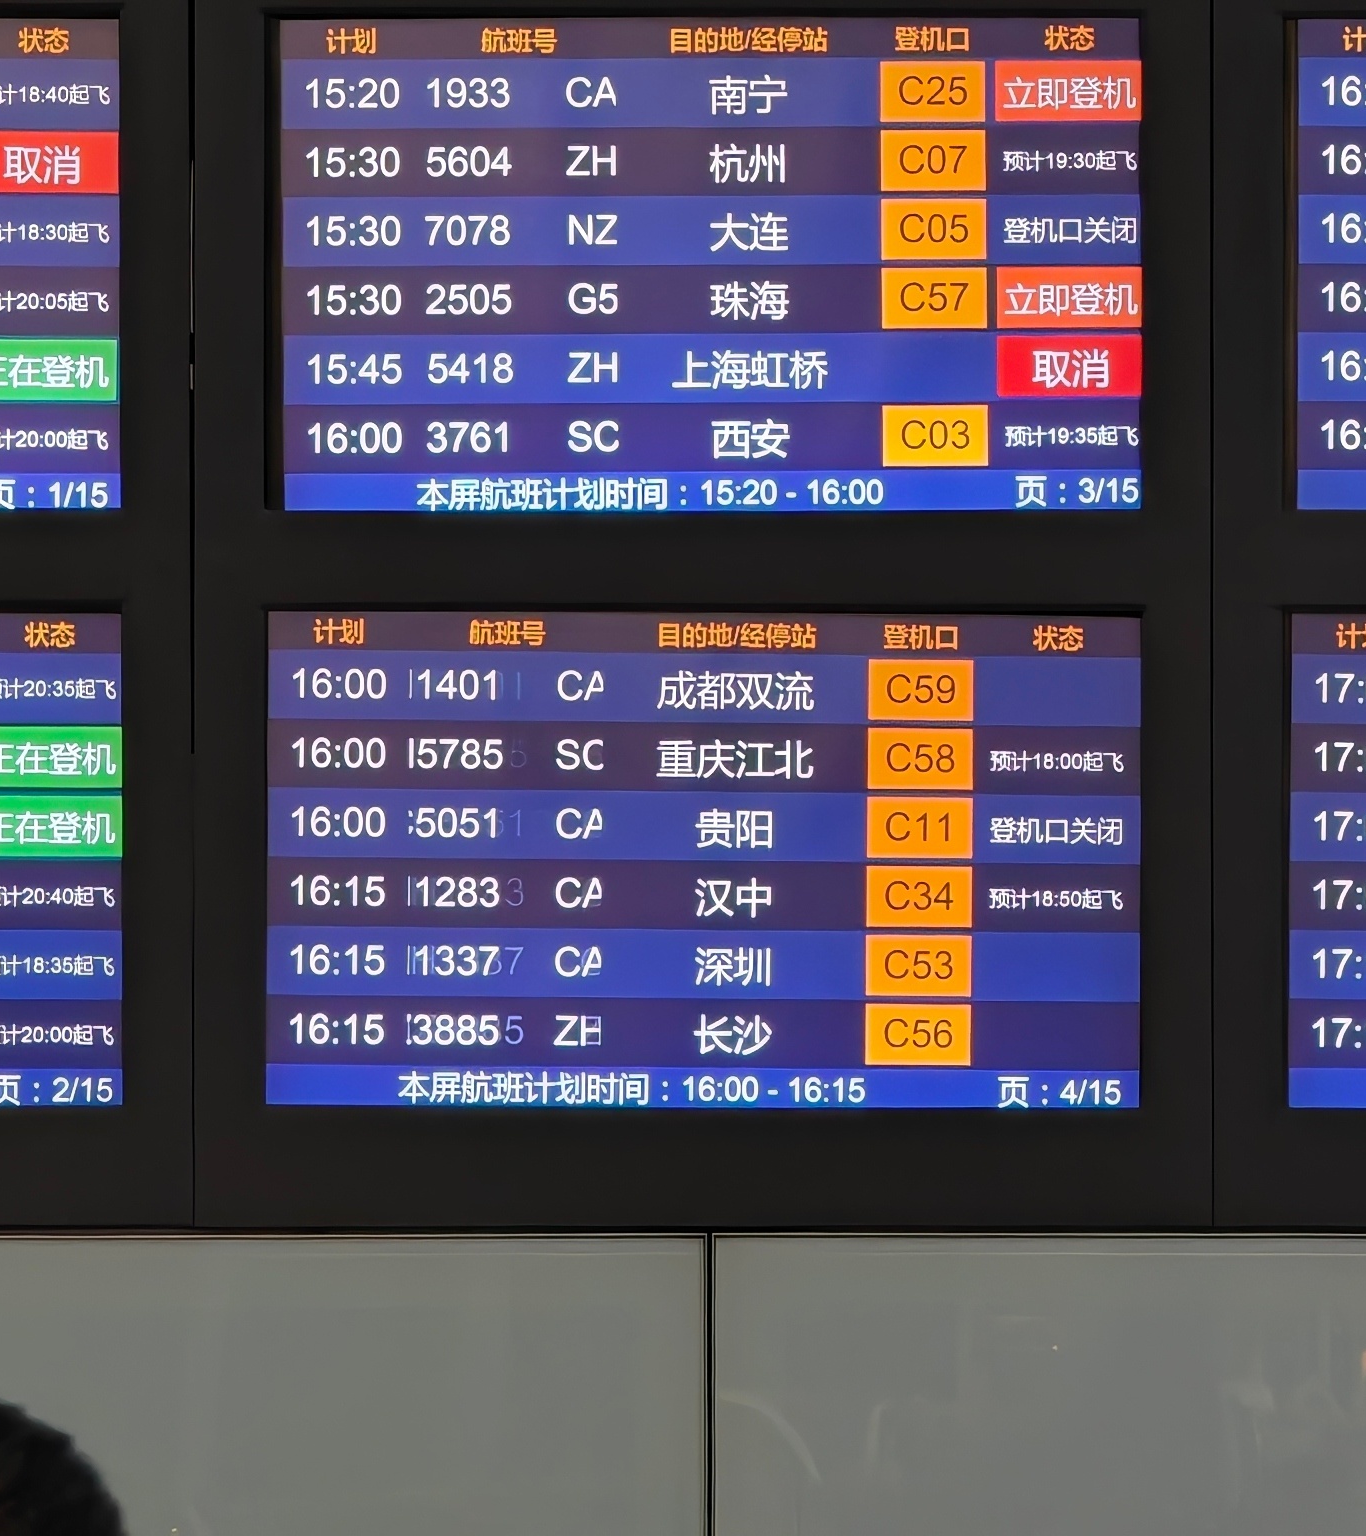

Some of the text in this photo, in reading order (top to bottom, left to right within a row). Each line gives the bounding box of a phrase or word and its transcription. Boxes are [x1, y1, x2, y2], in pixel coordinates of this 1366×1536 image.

[18, 27, 69, 53] 状态
[327, 28, 376, 54] 计划
[481, 28, 557, 53] 航班号
[671, 27, 827, 53] 目的地/经停站
[895, 26, 969, 52] 登机口
[1045, 25, 1094, 51] 状态
[306, 74, 1136, 115] 15:20 1933 CA 南宁 C25 立即登机
[3, 145, 80, 184] 取消
[306, 144, 1137, 183] 15:30 5604 ZH 杭州 C07 预计19:30起飞
[307, 212, 1136, 251] 15:30 7078 NZ 大连 C05 登机口关闭
[307, 281, 1138, 320] 15:30 2505 G5 珠海 C57 立即登机
[25, 621, 75, 648] 状态
[314, 618, 364, 644] 计划
[469, 619, 545, 646] 航班号
[659, 622, 817, 648] 目的地/经停站
[884, 625, 958, 650] 登机口
[1033, 625, 1083, 650] 状态
[293, 668, 955, 710] 16:00 成都双流 C59
[292, 737, 1124, 779] 16:00 重庆江北 C58 预计18:00起飞
[292, 806, 1122, 848] 16:00 贵阳 C11 登机口关闭
[291, 875, 1123, 918] 16:15 汉中 C34 预计18:50起飞
